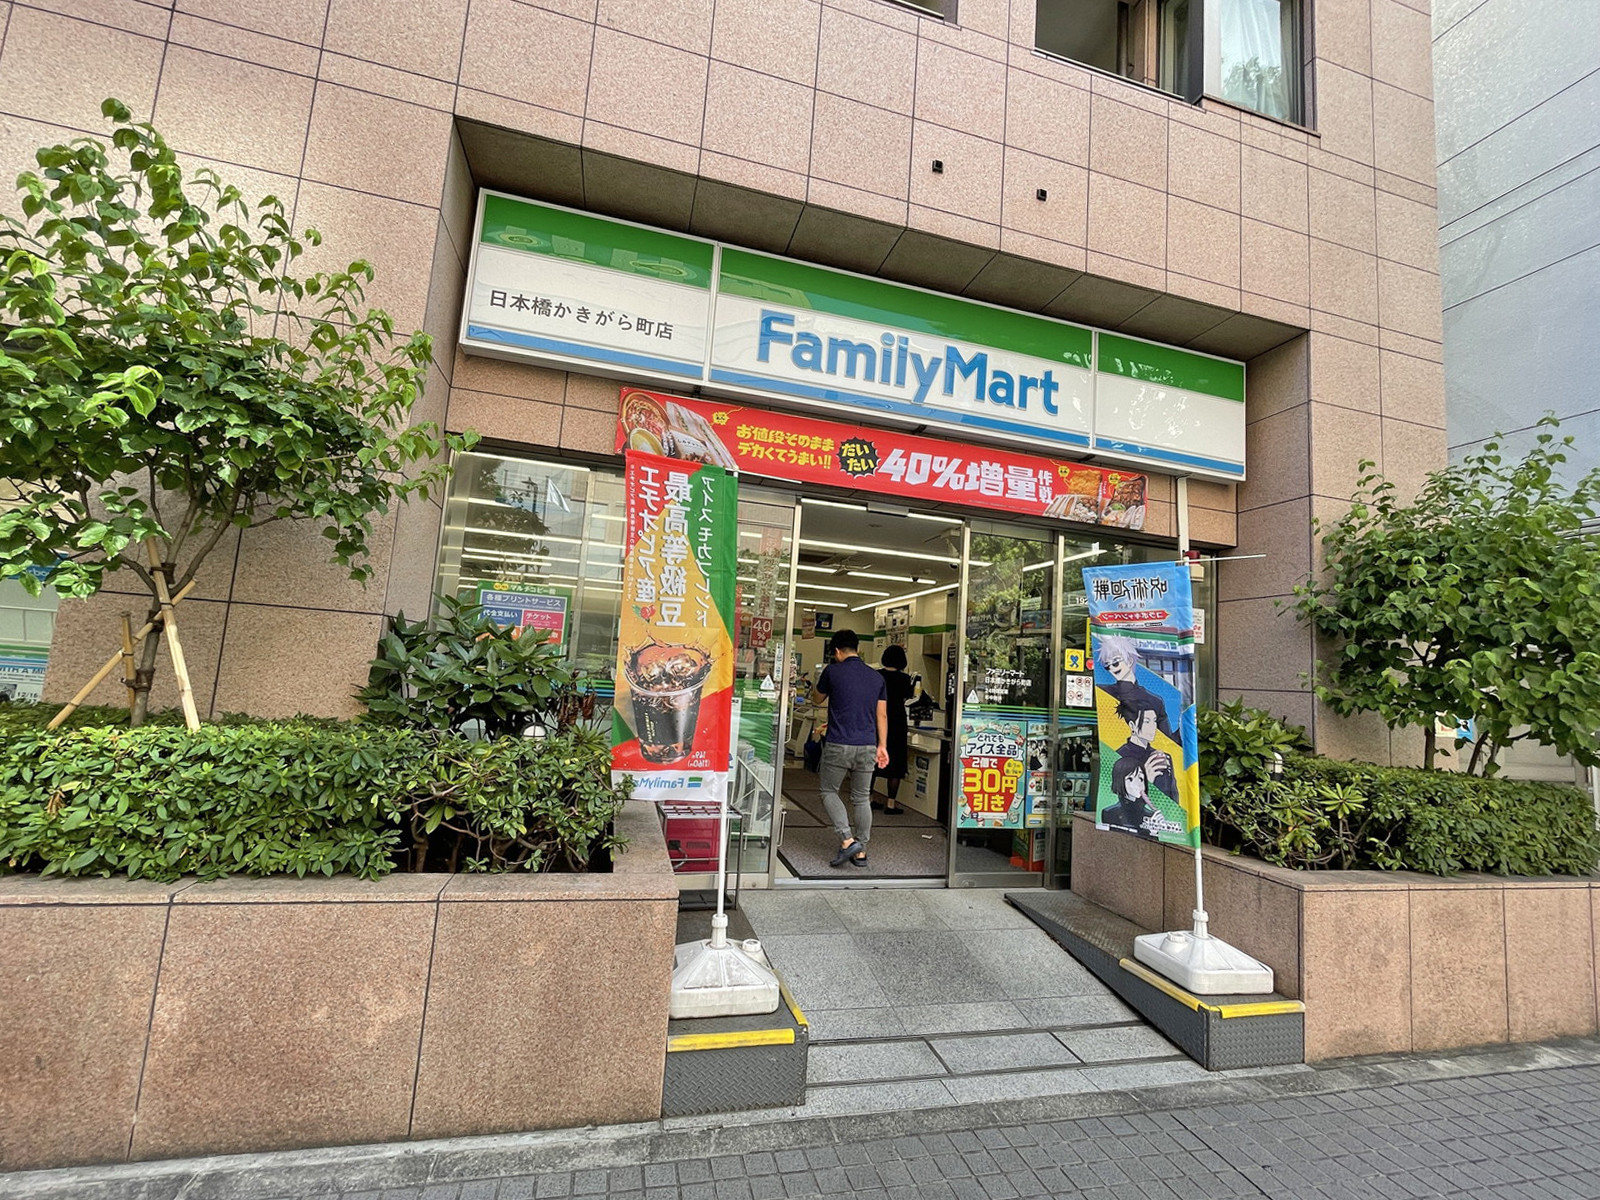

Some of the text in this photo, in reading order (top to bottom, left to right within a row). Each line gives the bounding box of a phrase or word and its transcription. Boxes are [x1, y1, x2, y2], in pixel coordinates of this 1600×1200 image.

[489, 289, 674, 341] 日本橋かきがら町店
[757, 309, 1060, 415] FamilyMart
[736, 424, 835, 451] お値段そのまま
[841, 442, 870, 458] だい
[847, 455, 875, 472] たい
[878, 448, 1054, 504] 40%増量 作戦
[486, 594, 561, 607] 各種プリントサービス
[752, 620, 771, 632] 40
[985, 667, 1025, 677] ファミリーマート
[977, 734, 1005, 742] どれでも
[967, 743, 1017, 756] アイス全品
[972, 757, 998, 768] 2個で
[964, 768, 1018, 793] 30円
[973, 793, 1005, 812] 引き
